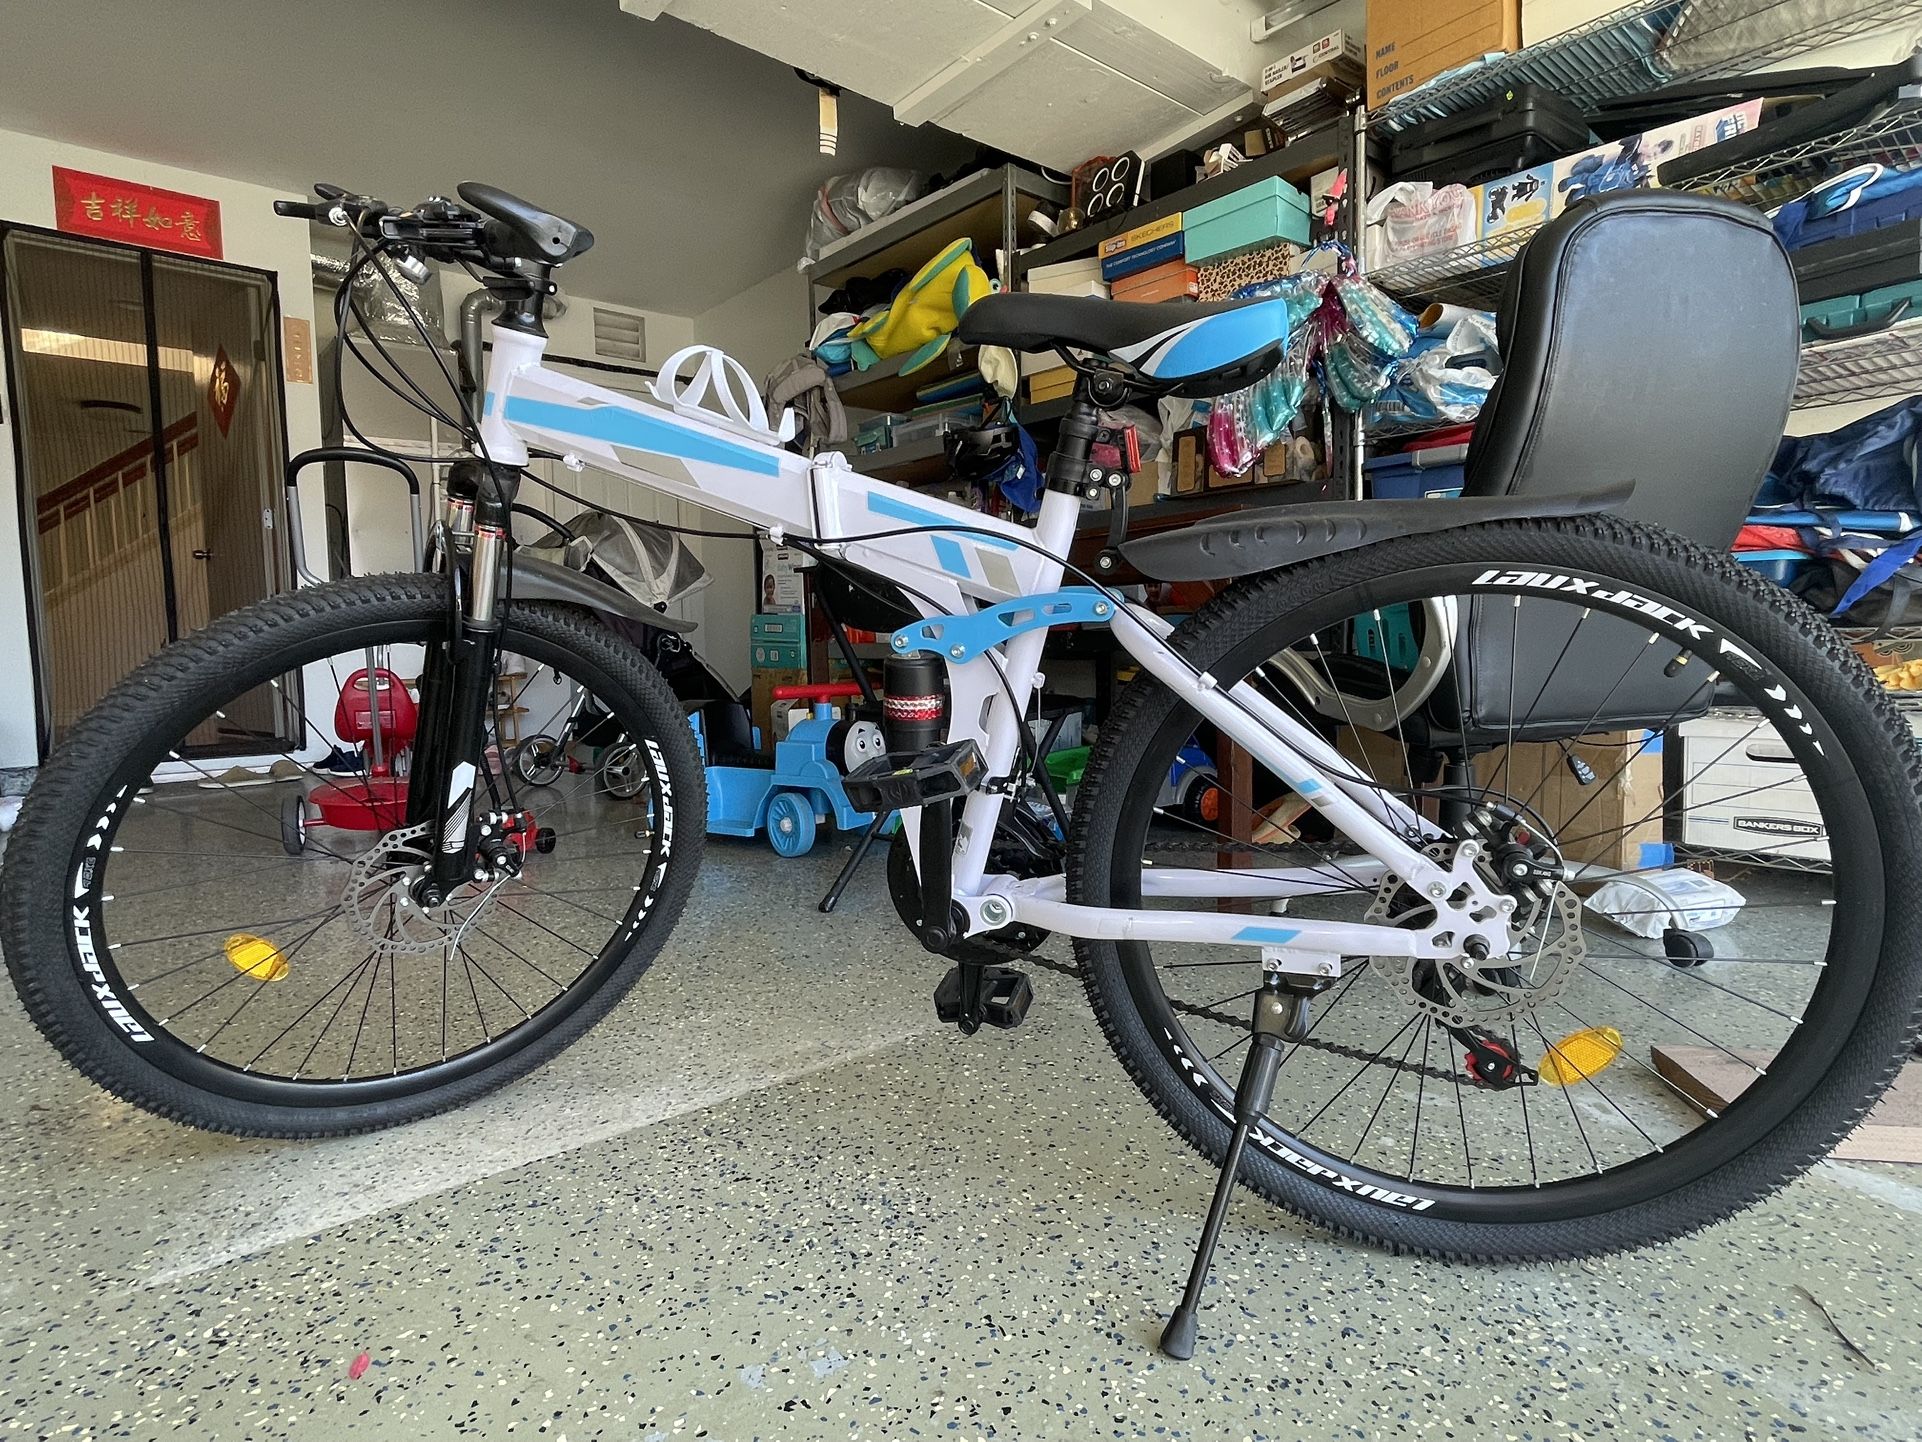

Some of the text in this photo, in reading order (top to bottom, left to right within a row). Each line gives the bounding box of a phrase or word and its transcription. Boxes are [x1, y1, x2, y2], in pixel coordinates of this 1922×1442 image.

[1376, 41, 1395, 59] NAME
[1376, 61, 1398, 79] FLOOR
[1376, 74, 1414, 100] CONTENTS
[80, 191, 201, 242] 吉祥如意
[1131, 221, 1174, 241] SKECHERS
[1131, 247, 1156, 259] TECHNOLOGY
[1156, 239, 1177, 251] COMPANY
[214, 361, 230, 412] 福
[1738, 820, 1819, 834] BANKERS BOX
